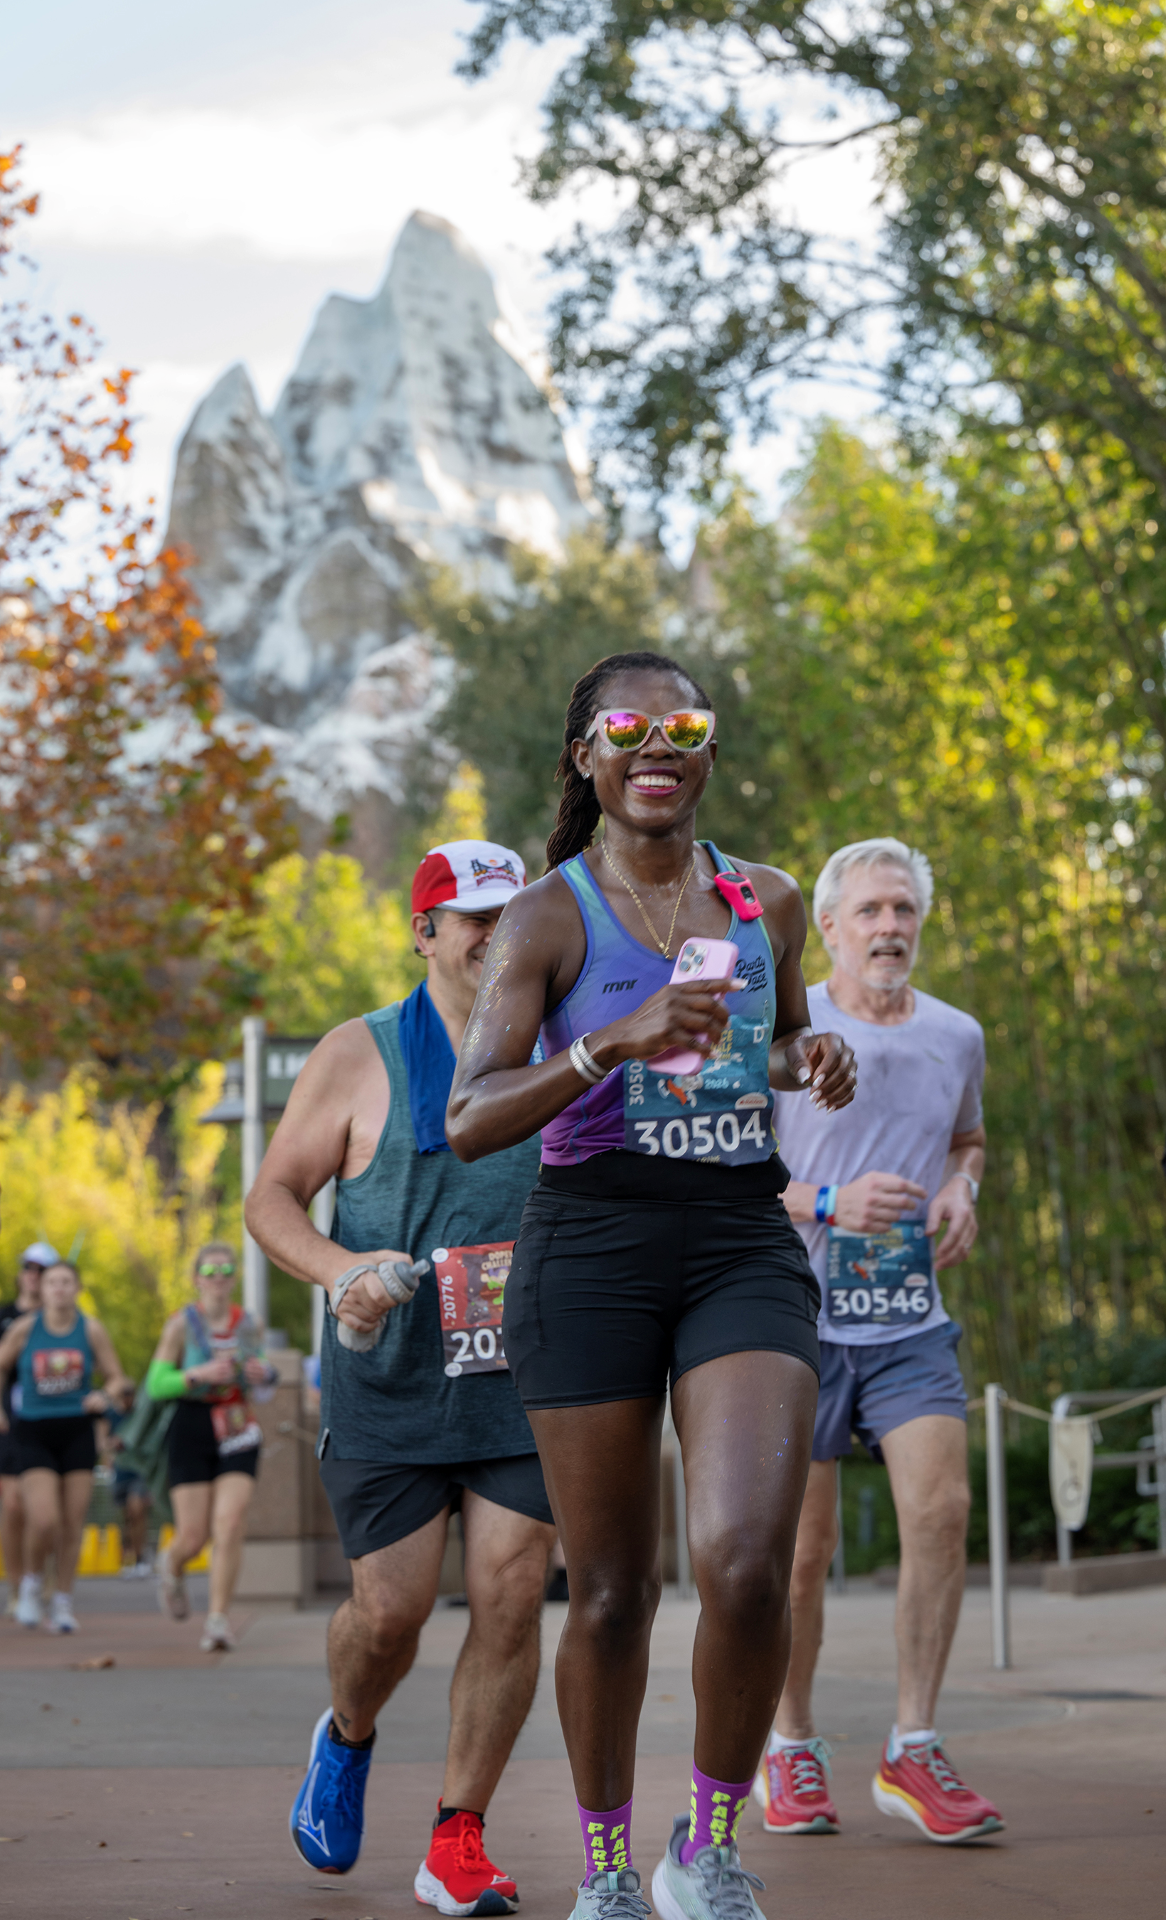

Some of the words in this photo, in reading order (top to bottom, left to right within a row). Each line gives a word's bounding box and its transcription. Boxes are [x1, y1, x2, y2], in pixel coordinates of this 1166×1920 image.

[752, 1025, 765, 1043] D
[628, 1057, 644, 1107] 3050
[633, 1110, 768, 1159] 30504
[440, 1275, 457, 1321] 20776
[830, 1287, 931, 1317] 30546
[450, 1327, 506, 1364] 20
[709, 1790, 732, 1850] PART
